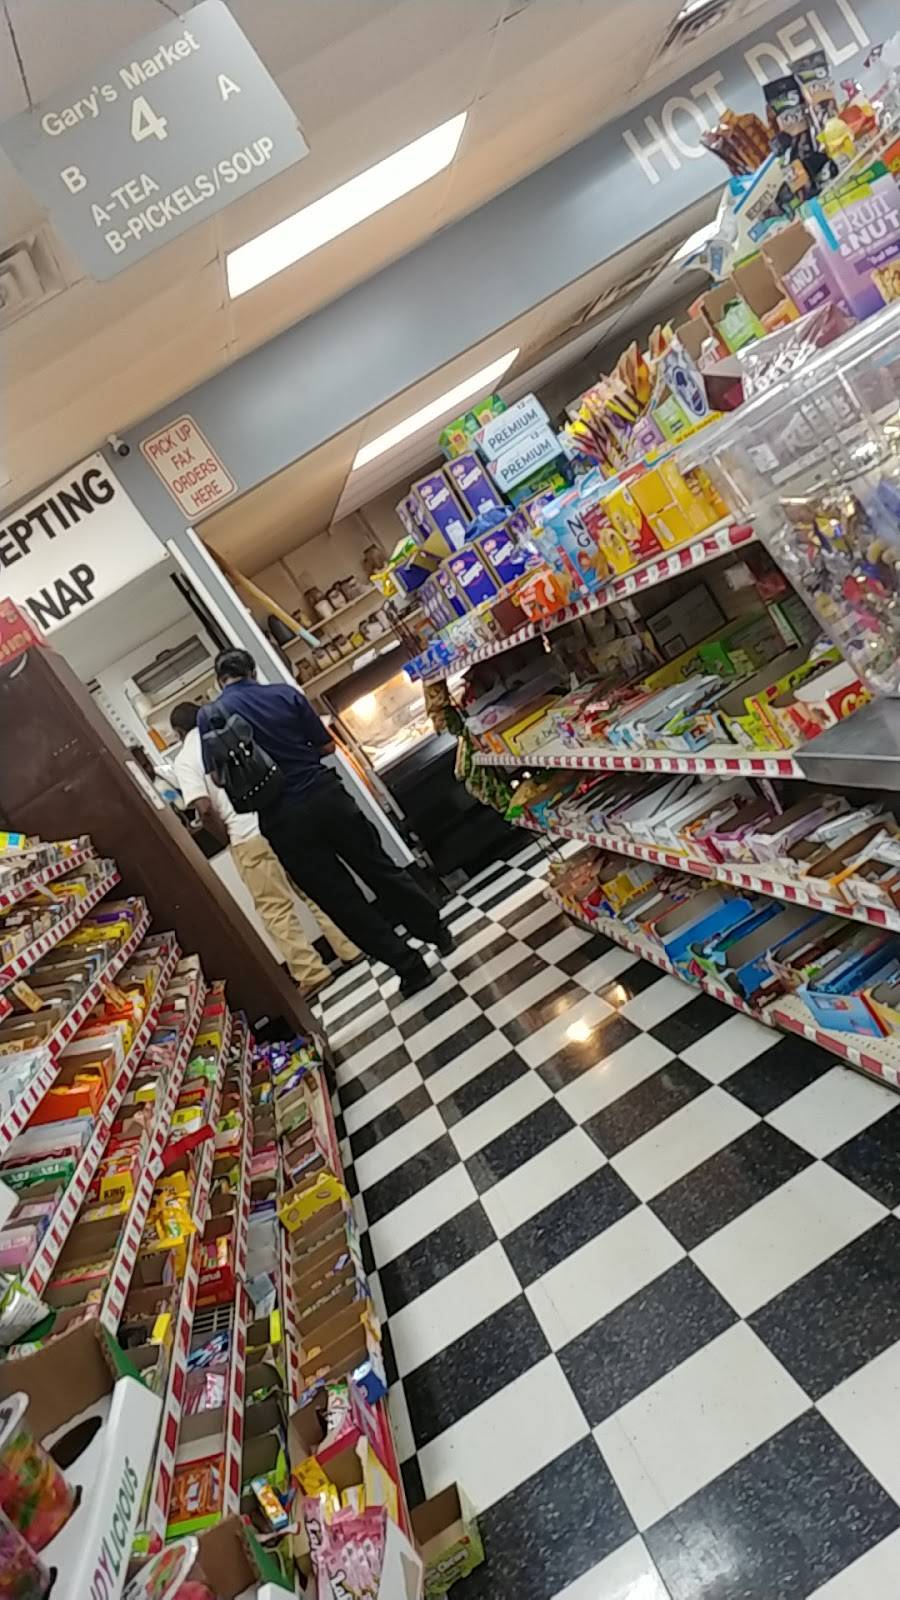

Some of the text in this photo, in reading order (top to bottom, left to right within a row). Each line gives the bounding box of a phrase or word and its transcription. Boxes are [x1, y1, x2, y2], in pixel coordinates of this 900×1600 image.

[41, 30, 200, 136] Gary's Market
[217, 73, 241, 101] A
[622, 0, 870, 184] HOT DELI
[130, 95, 168, 142] 4
[60, 165, 87, 194] B
[104, 136, 275, 255] B-PICKELS/SOUP
[90, 174, 160, 227] A-TEA
[148, 424, 191, 459] PICK UP
[487, 408, 538, 449] PREMIUM
[171, 447, 195, 470] FAX
[173, 458, 218, 494] ORDERS
[500, 438, 552, 480] PREMIUM
[190, 479, 223, 507] HERE
[0, 468, 116, 573] EPTING
